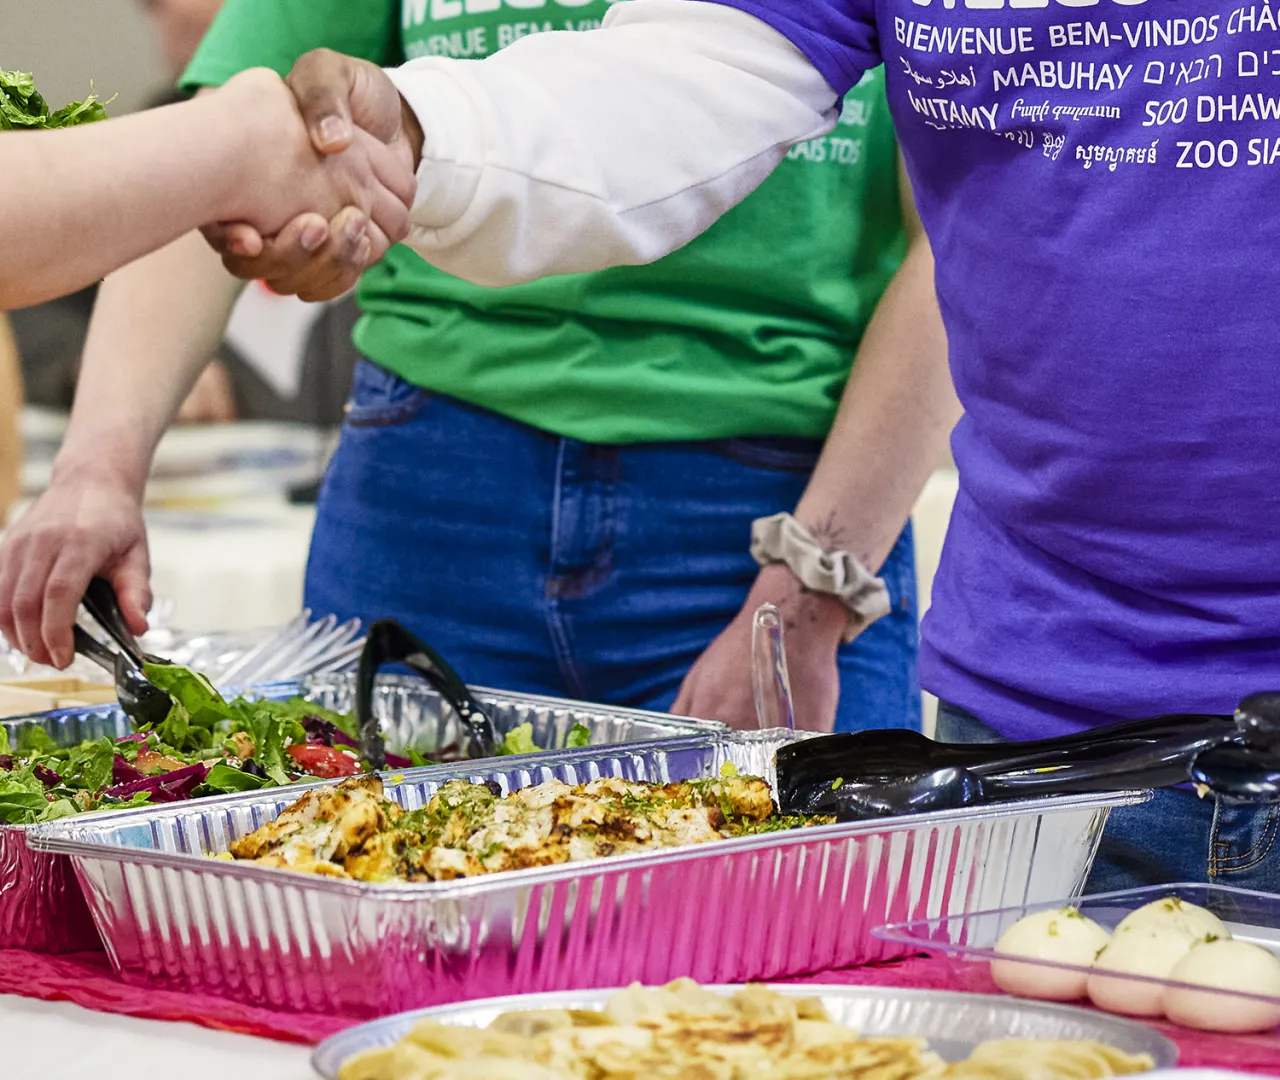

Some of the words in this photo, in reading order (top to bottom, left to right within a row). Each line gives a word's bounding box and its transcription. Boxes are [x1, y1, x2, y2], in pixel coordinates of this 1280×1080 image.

[894, 16, 1035, 55] BIENVENUE
[1048, 14, 1220, 48] BEM-VINDOS
[992, 60, 1134, 92] MABUHAY
[1142, 53, 1222, 86] הבאים
[907, 89, 999, 131] WITAMY
[1141, 98, 1189, 127] SOO
[829, 136, 862, 165] TOS
[1175, 139, 1239, 169] ZOO
